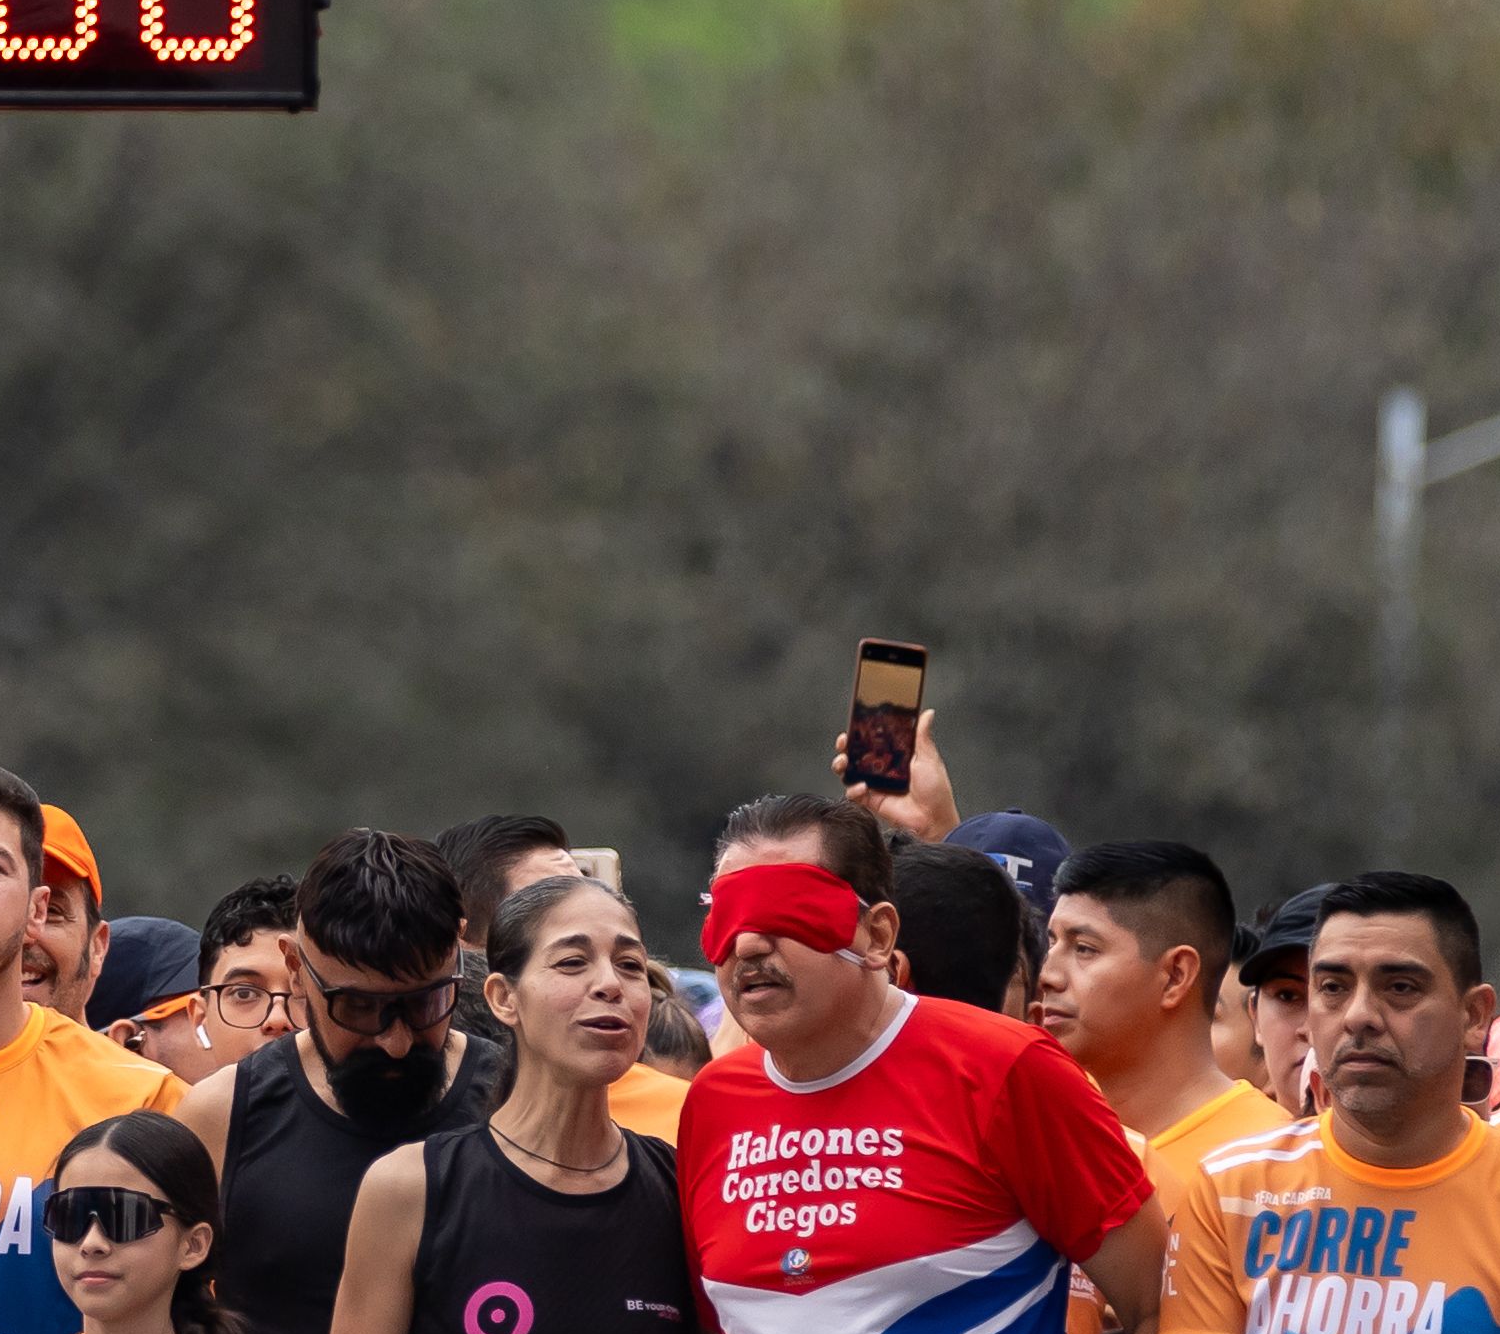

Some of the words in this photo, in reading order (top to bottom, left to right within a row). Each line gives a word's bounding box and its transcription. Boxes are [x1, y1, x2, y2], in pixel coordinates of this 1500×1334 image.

[728, 1123, 905, 1172] Halcones
[721, 1160, 905, 1203] Corredores
[745, 1199, 857, 1238] Ciegos
[1244, 1207, 1416, 1281] CORRE
[626, 1298, 644, 1312] BE
